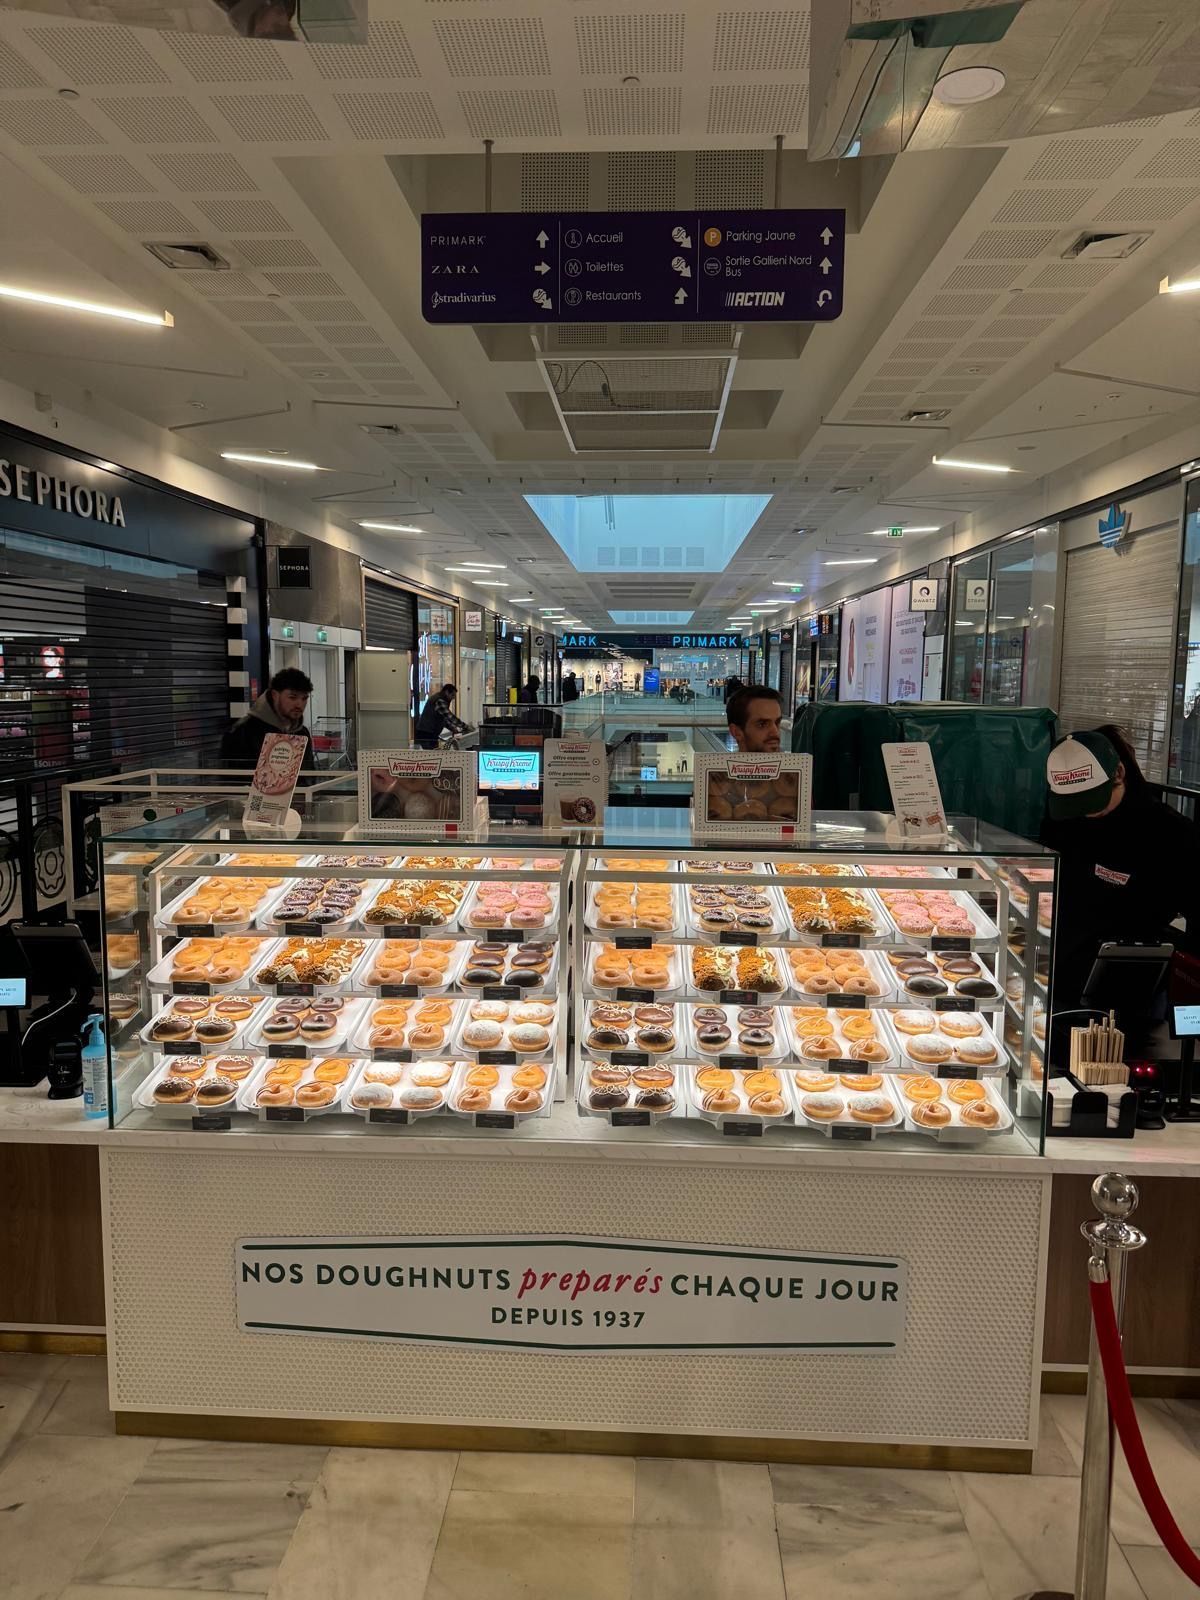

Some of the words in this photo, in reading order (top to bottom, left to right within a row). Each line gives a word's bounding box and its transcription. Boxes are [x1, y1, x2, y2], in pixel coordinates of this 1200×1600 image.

[430, 235, 485, 246] PRIMARK
[586, 231, 624, 244] Accueil
[726, 230, 763, 244] Parking
[765, 231, 796, 242] Jaune
[585, 261, 624, 273] Toilettes
[725, 255, 751, 267] Sortie
[753, 255, 787, 267] Gallieni
[789, 255, 812, 266] Nord
[431, 265, 480, 275] ZARA
[725, 266, 742, 278] Bus
[586, 289, 642, 302] Restaurants
[733, 291, 786, 307] ACTION
[0, 459, 126, 528] SEPHORA
[672, 636, 737, 647] PRIMARK
[392, 761, 416, 772] Krispy
[415, 761, 438, 771] Kreme
[486, 757, 510, 768] Krispy
[509, 757, 532, 768] Kreme
[731, 764, 754, 775] Krispy
[754, 764, 778, 774] Kreme
[1069, 768, 1090, 780] Kreme
[241, 1261, 304, 1285] NOS
[316, 1264, 511, 1291] DOUGHNUTS
[517, 1267, 663, 1301] preparés
[670, 1274, 804, 1303] CHAQUE
[814, 1278, 899, 1302] JOUR
[491, 1306, 584, 1327] DEPUIS
[592, 1310, 646, 1328] 1937
